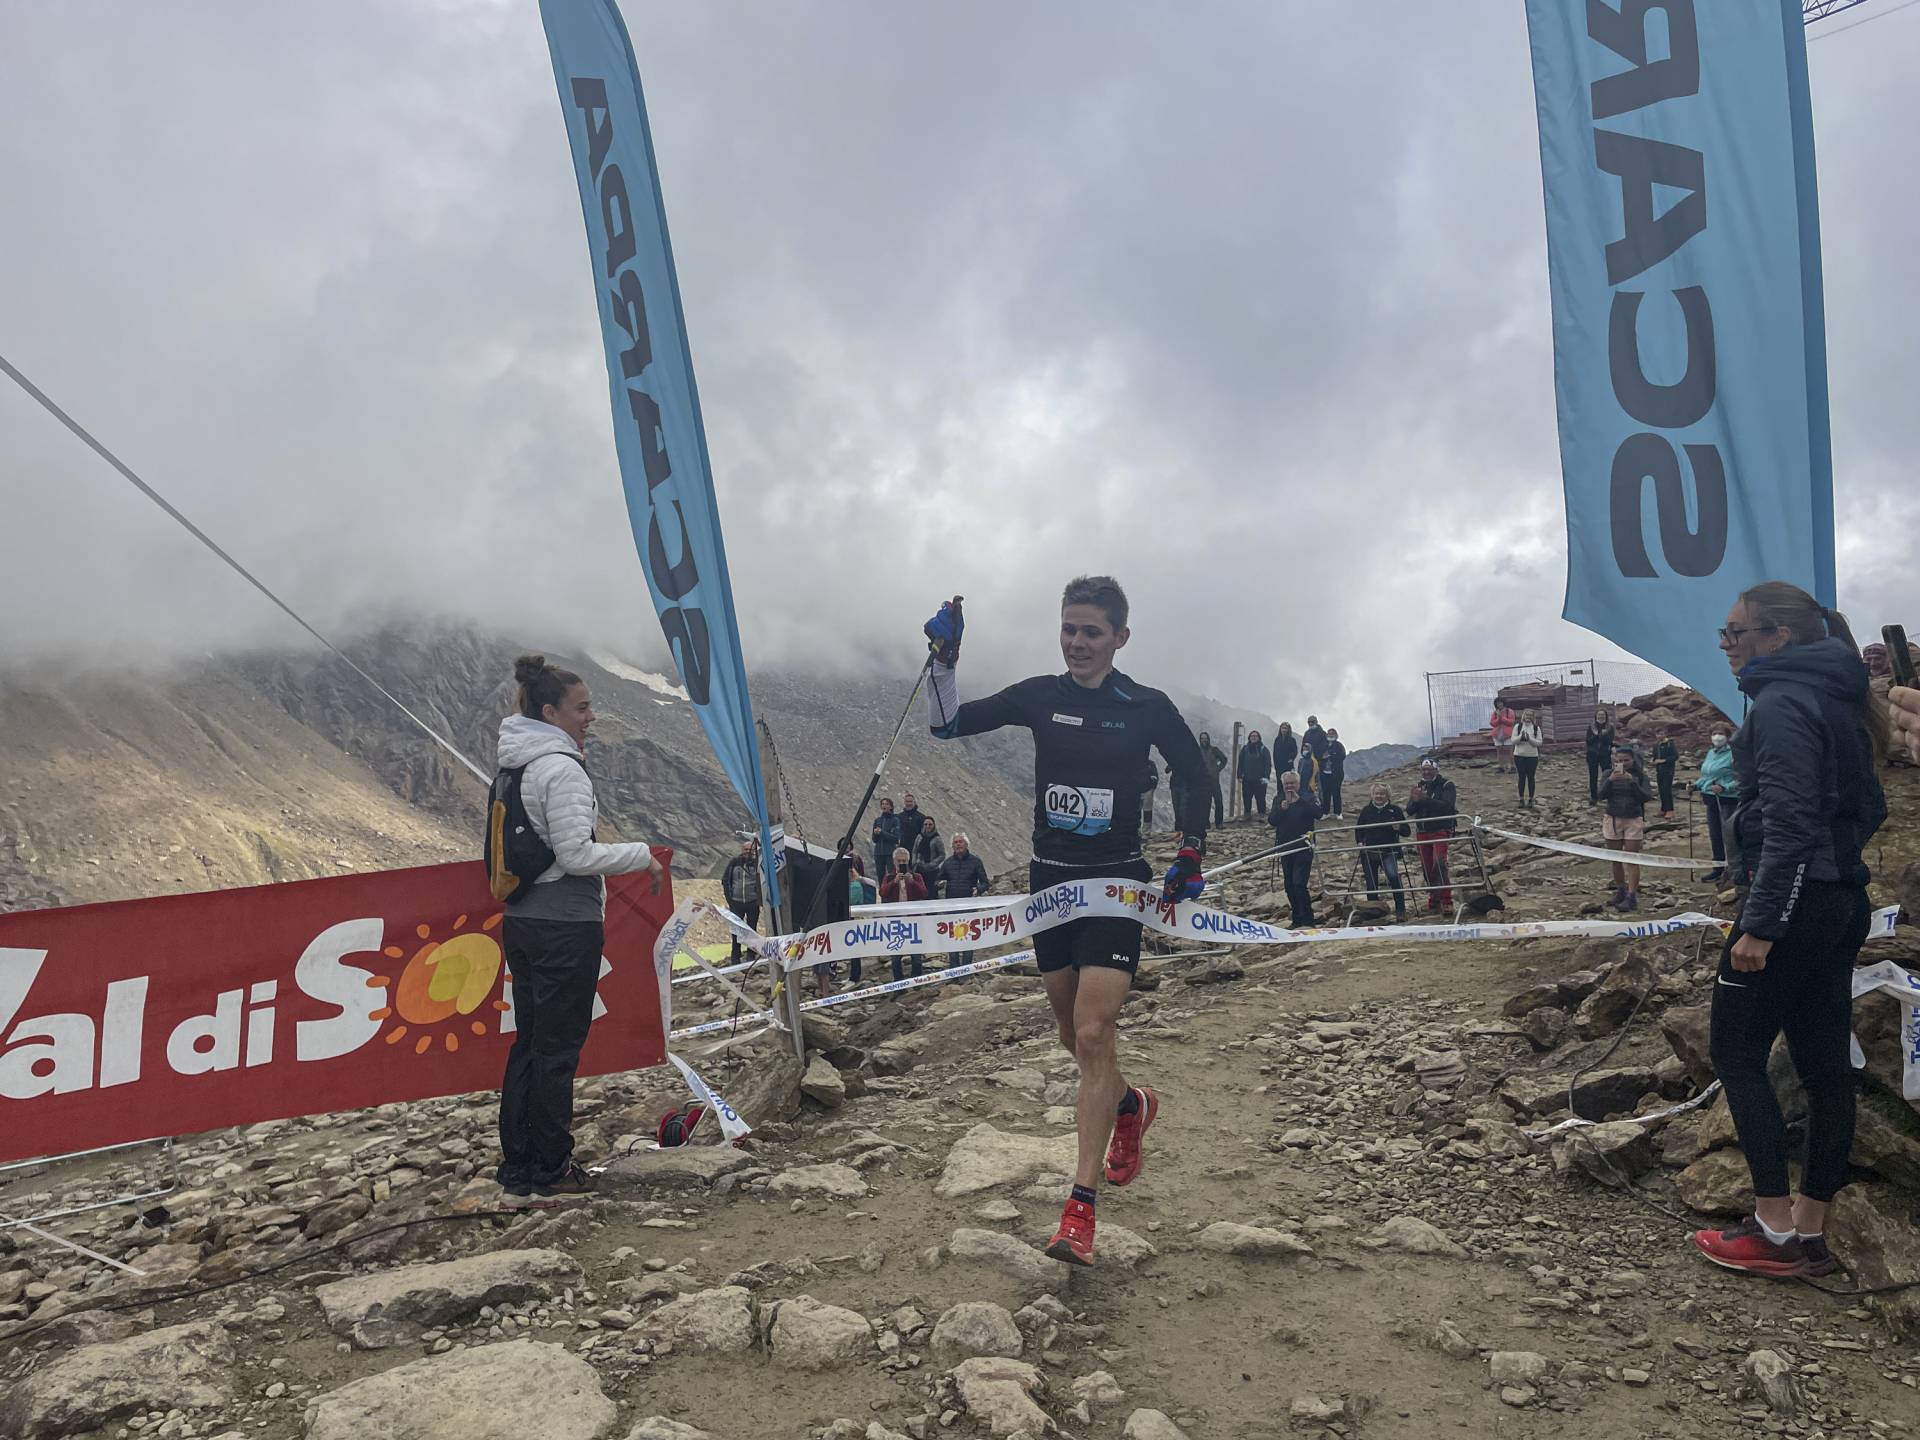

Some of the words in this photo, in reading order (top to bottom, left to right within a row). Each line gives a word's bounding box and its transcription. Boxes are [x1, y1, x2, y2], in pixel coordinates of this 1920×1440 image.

[1048, 791, 1080, 815] 042
[1025, 885, 1088, 923] TRENTINO
[1105, 884, 1146, 913] Sole
[1780, 863, 1806, 922] Kappa
[844, 920, 923, 946] TRENTINO
[937, 918, 981, 941] Sole
[982, 918, 994, 930] di
[994, 912, 1016, 935] Val
[1191, 911, 1278, 940] TRENTINO
[813, 930, 832, 955] Val
[166, 980, 278, 1075] di
